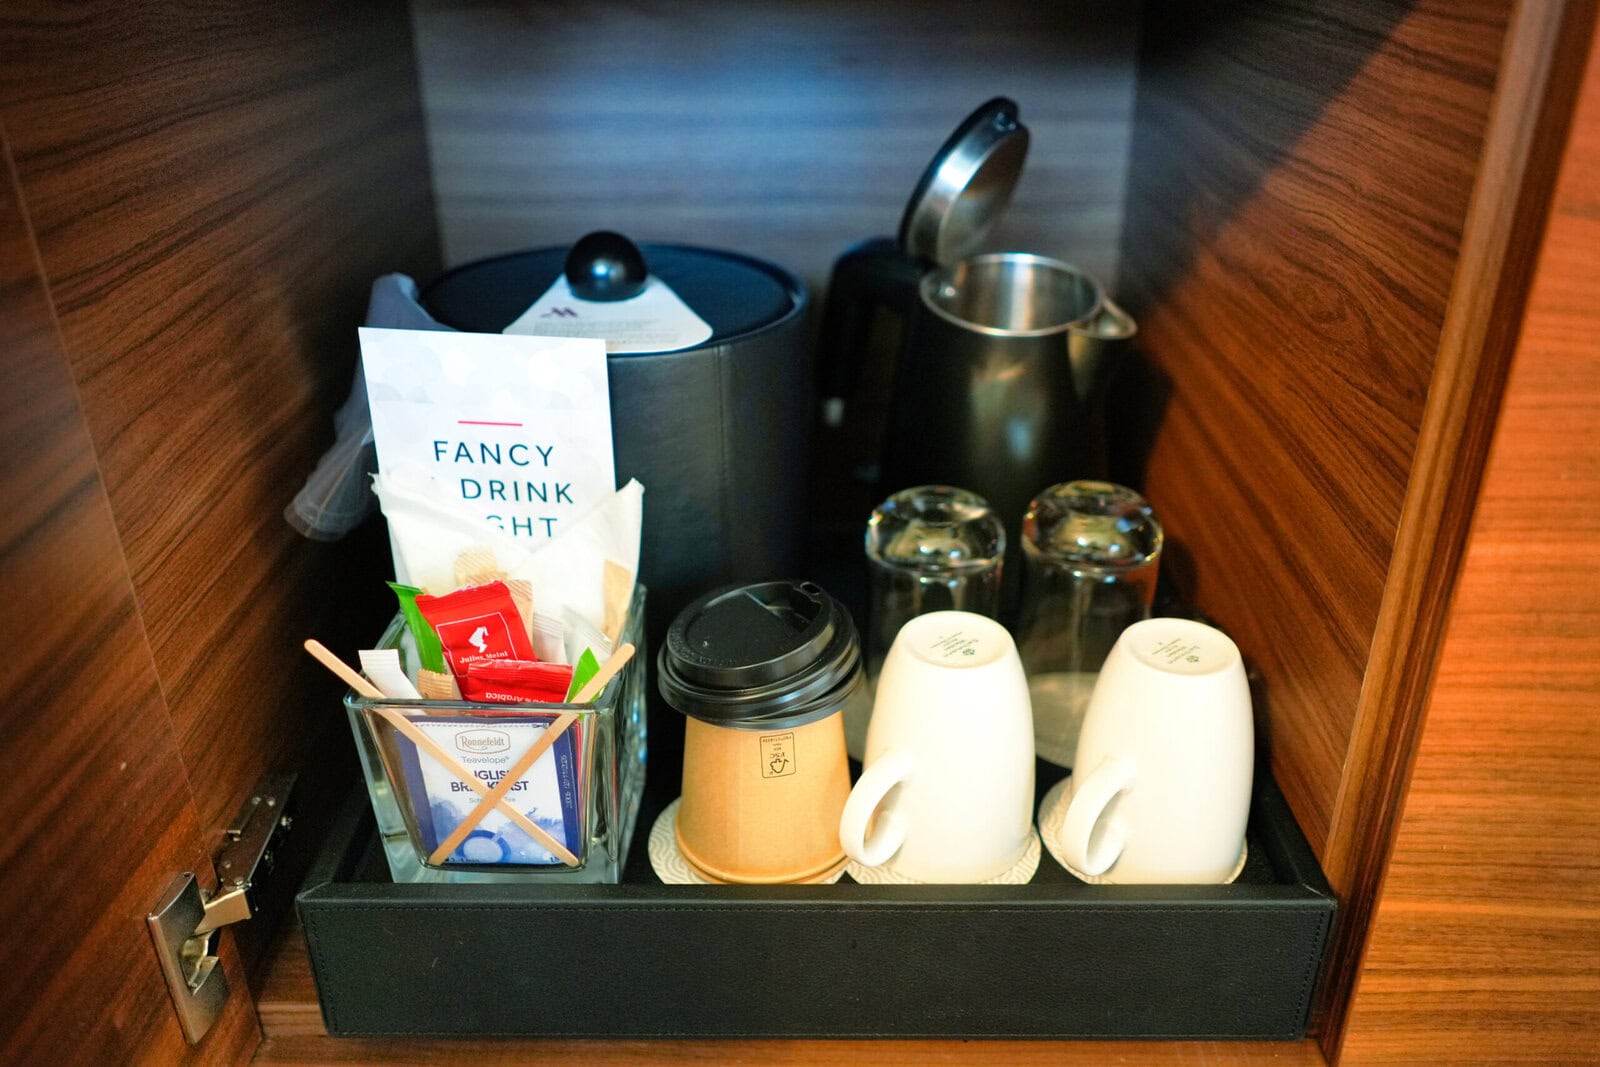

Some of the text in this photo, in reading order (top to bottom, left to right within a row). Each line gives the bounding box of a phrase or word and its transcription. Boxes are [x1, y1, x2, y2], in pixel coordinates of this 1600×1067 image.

[433, 440, 553, 467] FANCY
[460, 478, 573, 504] DRINK
[461, 735, 505, 748] Ronnefeldt
